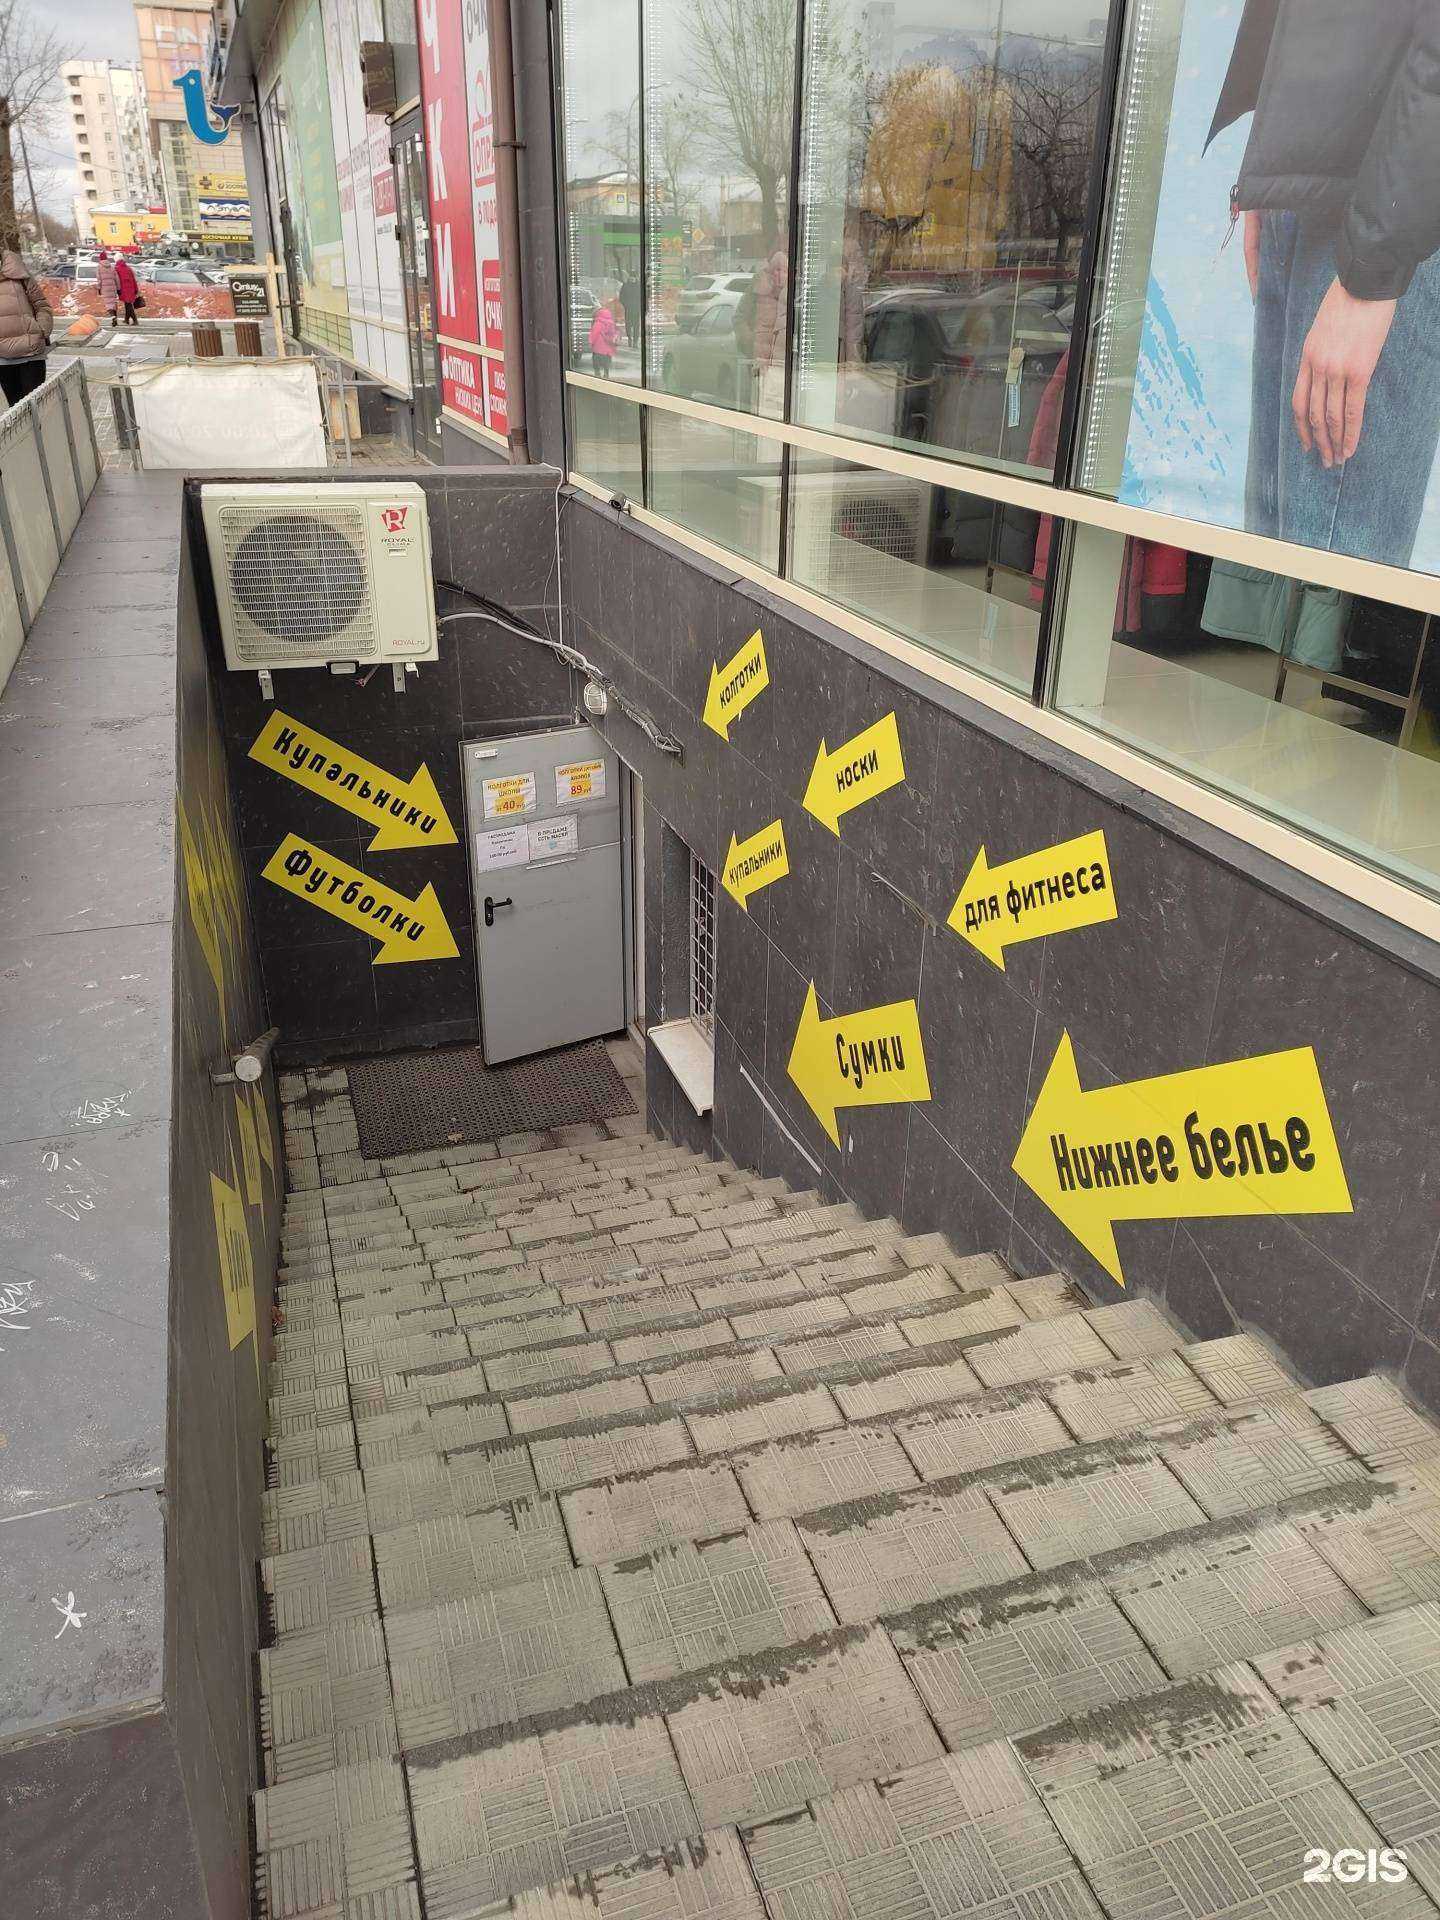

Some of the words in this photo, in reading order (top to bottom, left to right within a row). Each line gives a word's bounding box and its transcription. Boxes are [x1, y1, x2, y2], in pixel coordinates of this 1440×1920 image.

[485, 300, 502, 330] ОЧК
[448, 355, 476, 390] ОПТИКА
[272, 727, 438, 834] Купальники
[503, 800, 516, 811] 40
[571, 785, 583, 795] 89
[728, 839, 783, 888] купальники
[284, 849, 426, 942] Футболки
[964, 895, 1000, 933] для
[1006, 862, 1106, 923] фитнеса
[835, 1032, 906, 1090] Сумки
[1050, 1133, 1180, 1192] Нижнее
[1184, 1110, 1316, 1180] белье
